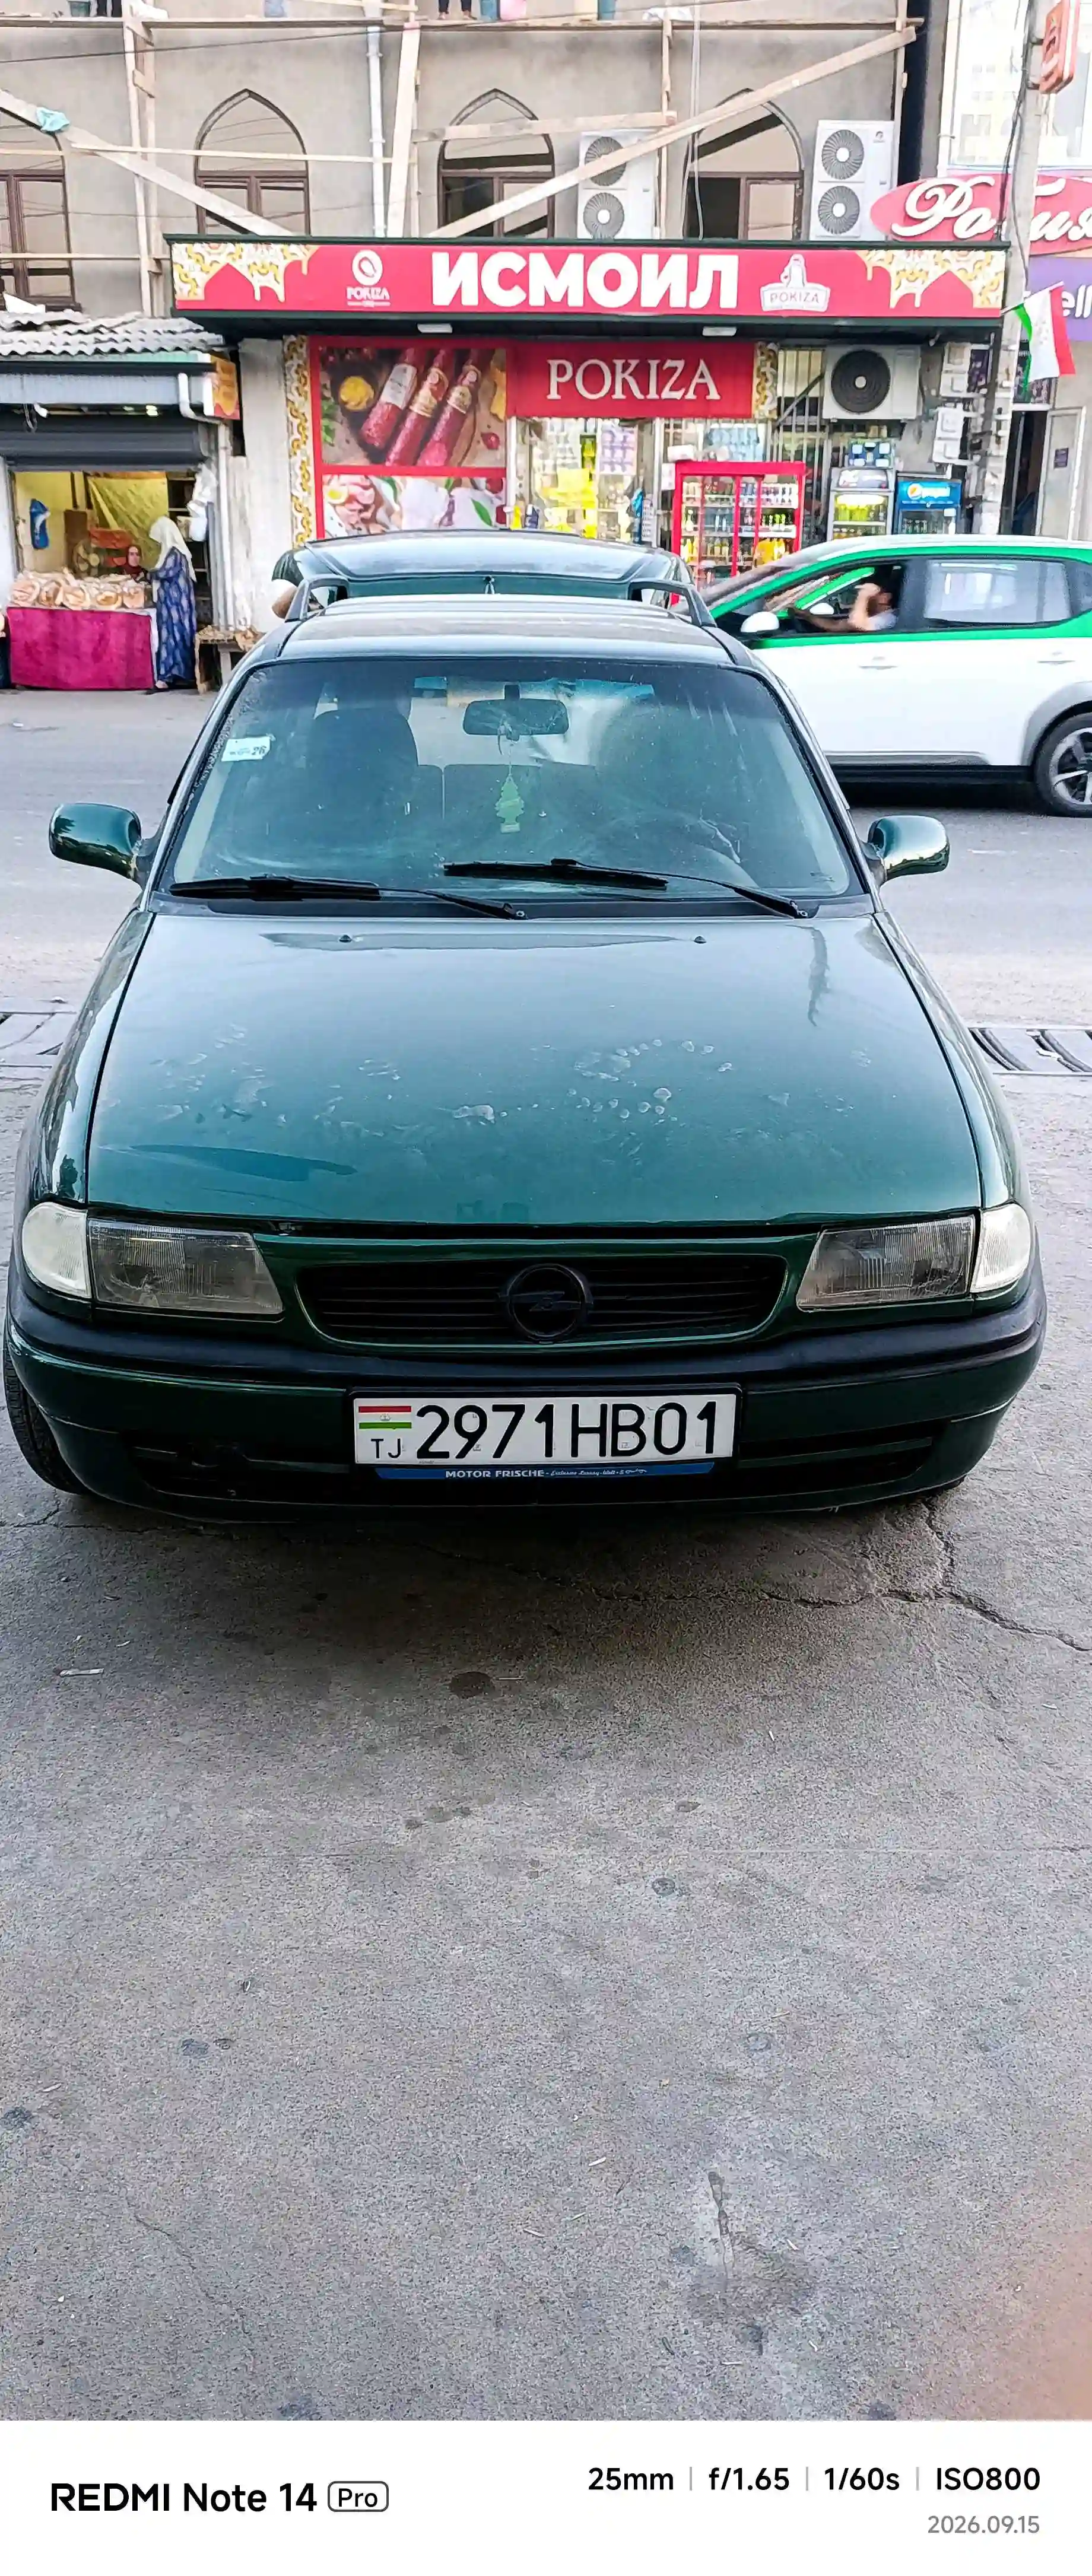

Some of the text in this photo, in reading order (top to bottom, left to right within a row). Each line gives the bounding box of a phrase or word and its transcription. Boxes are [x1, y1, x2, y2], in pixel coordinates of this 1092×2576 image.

[431, 251, 739, 309] ИСМОИЛ
[770, 291, 819, 304] POKIZA
[547, 359, 721, 400] POKIZA
[370, 1401, 717, 1459] TJ 2971HB01
